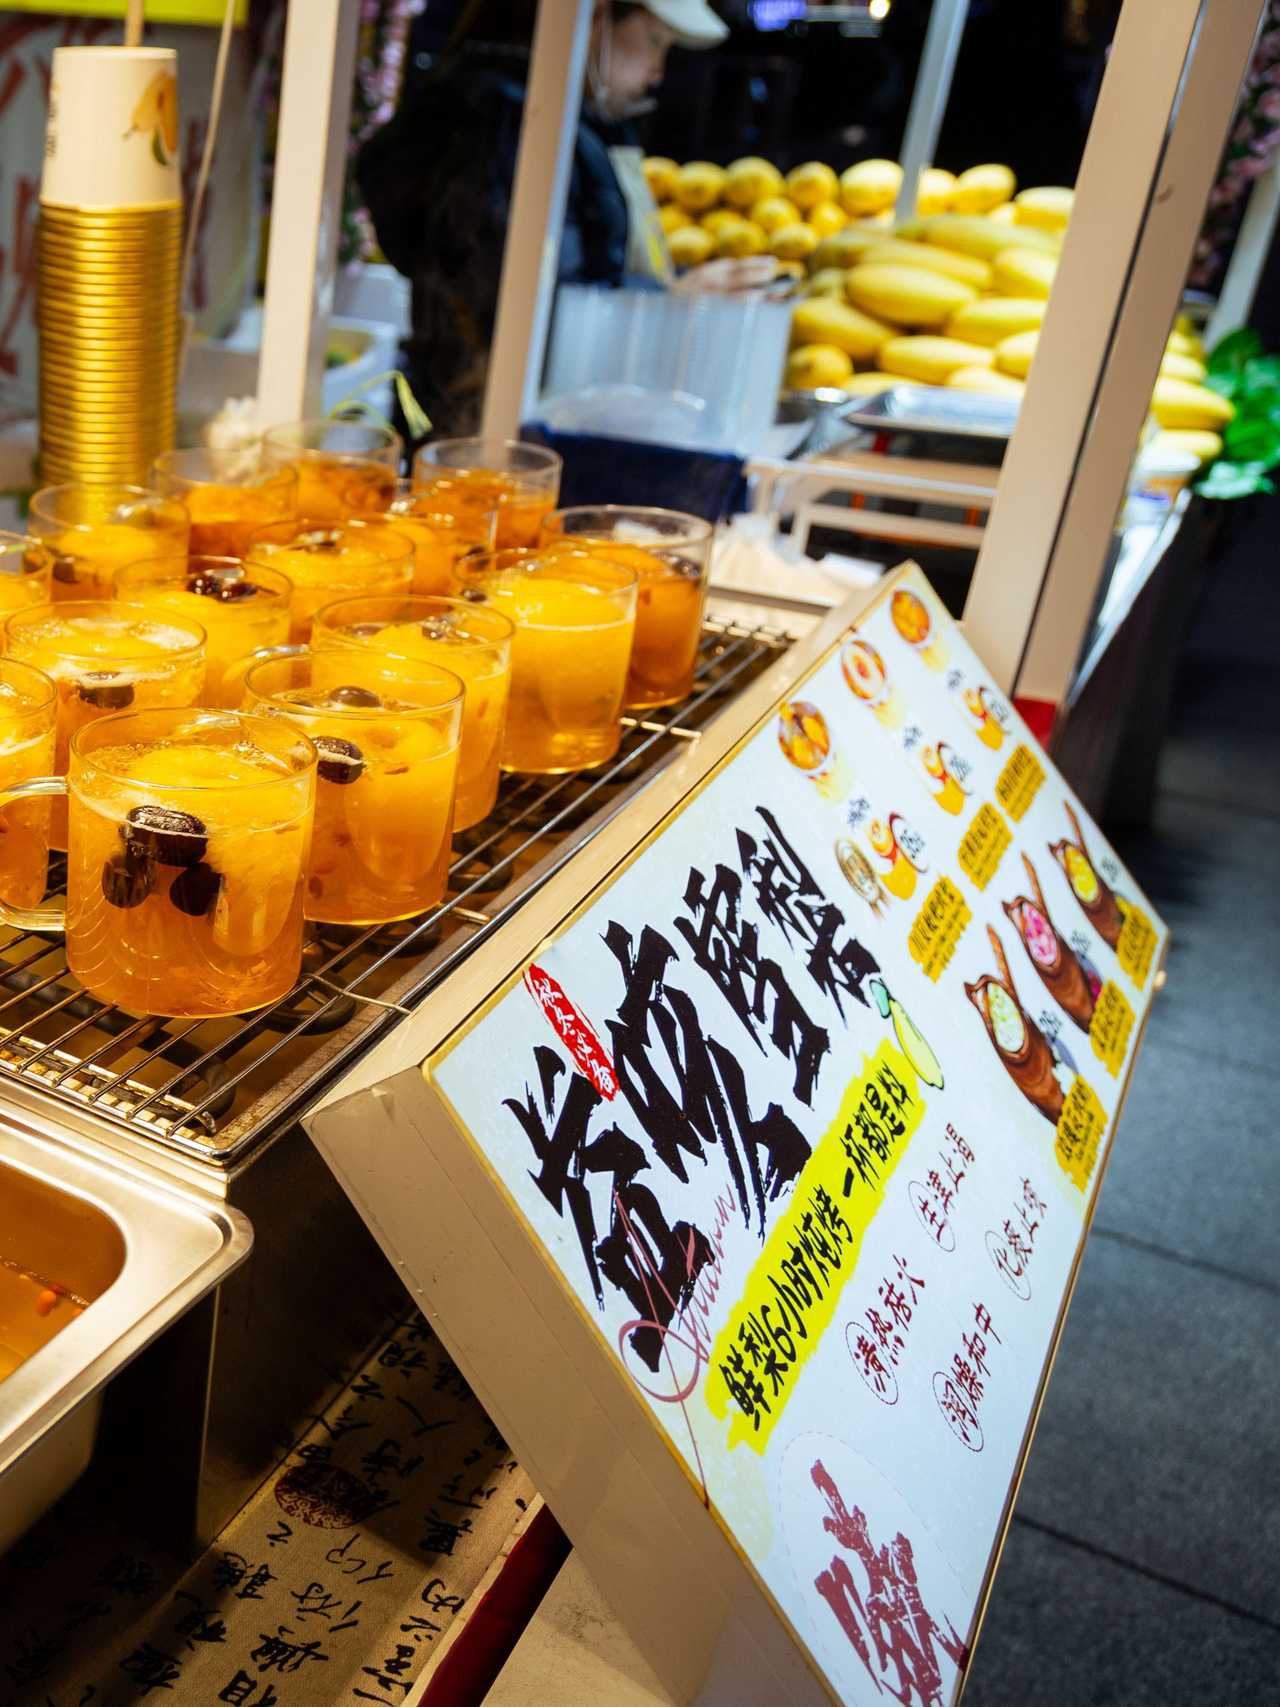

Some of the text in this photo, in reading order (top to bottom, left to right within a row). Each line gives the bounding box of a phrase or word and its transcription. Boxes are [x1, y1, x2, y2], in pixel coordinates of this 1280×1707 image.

[532, 972, 615, 1094] 秋冬必备
[719, 1067, 911, 1431] 鲜梨6小时炖烤 一杯都是料
[855, 1123, 977, 1391] 清热祛火 生津止渴
[944, 1177, 1047, 1439] 润燥和中 化痰止咳
